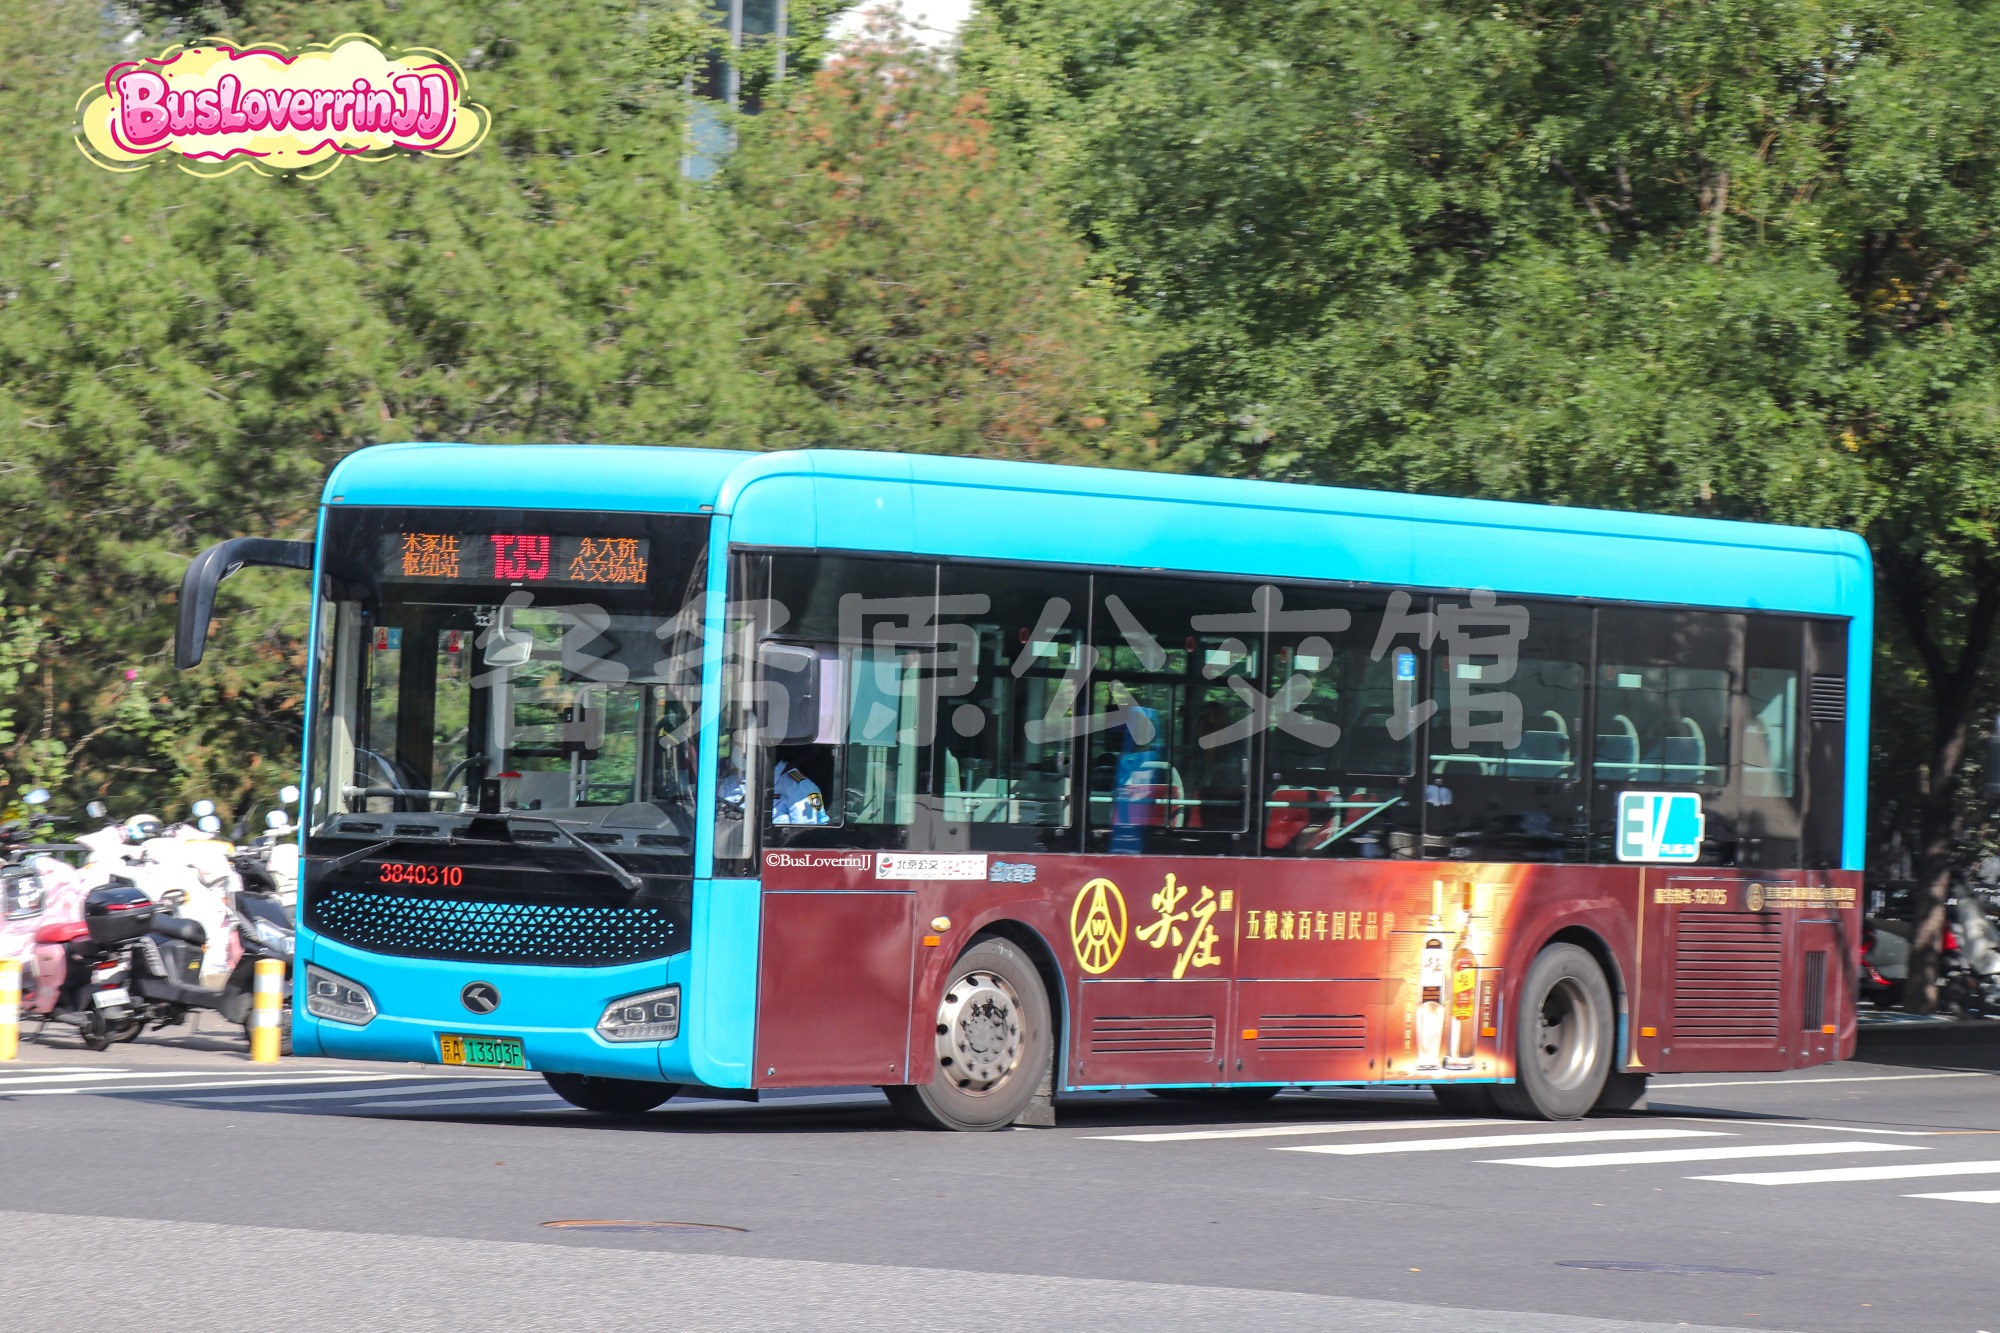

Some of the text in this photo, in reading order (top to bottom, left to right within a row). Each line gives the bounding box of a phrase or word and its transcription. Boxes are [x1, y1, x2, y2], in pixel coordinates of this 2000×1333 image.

[401, 551, 460, 578] 枢纽站
[568, 556, 648, 583] 公交场站
[1621, 795, 1672, 857] EV
[380, 863, 463, 886] 3840310
[897, 860, 939, 870] 北京公交
[1135, 872, 1222, 979] 尖庄
